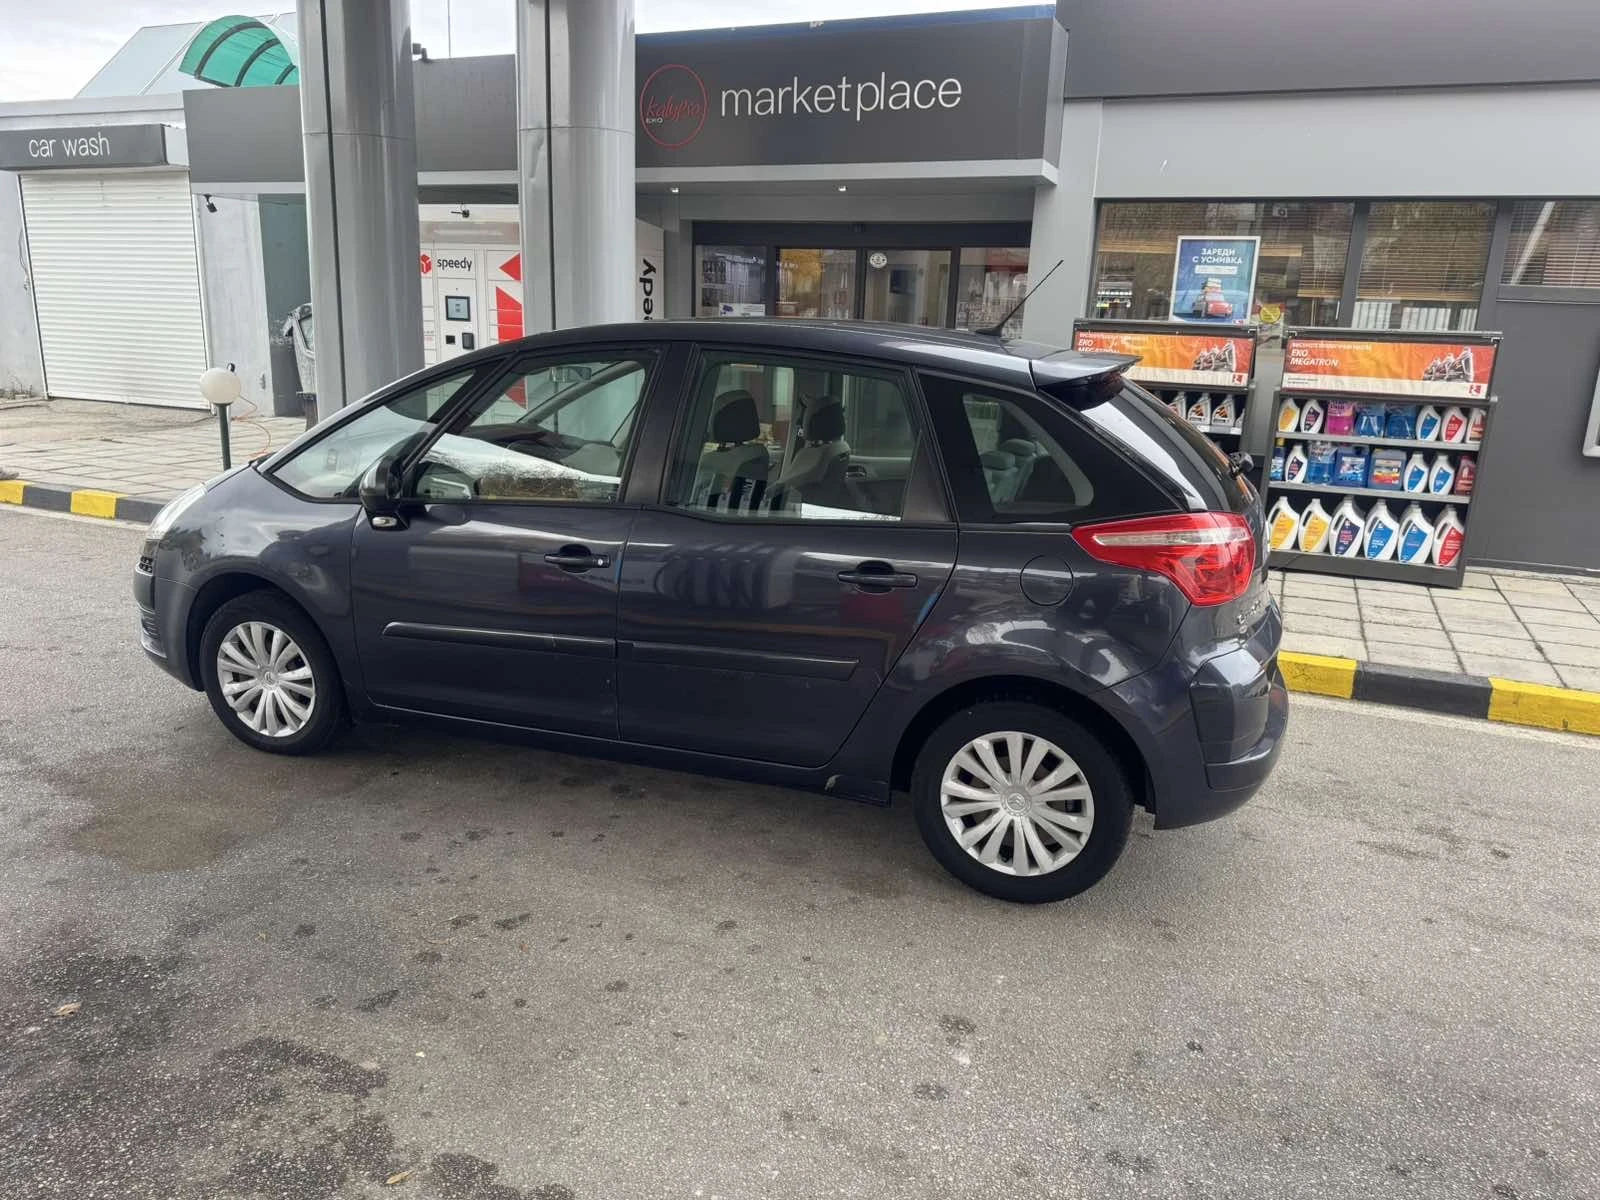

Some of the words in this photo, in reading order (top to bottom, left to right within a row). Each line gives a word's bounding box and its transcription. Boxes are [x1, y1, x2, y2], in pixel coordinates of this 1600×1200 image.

[721, 72, 962, 121] marketplace
[28, 138, 56, 158] car
[62, 132, 111, 157] wash
[1200, 248, 1236, 256] ЗАРЕДИ
[437, 257, 473, 271] speedy
[1200, 256, 1243, 264] УСМИВКА
[1078, 338, 1094, 347] EKO
[1291, 348, 1309, 357] EKO
[1290, 358, 1339, 368] MEGATRON
